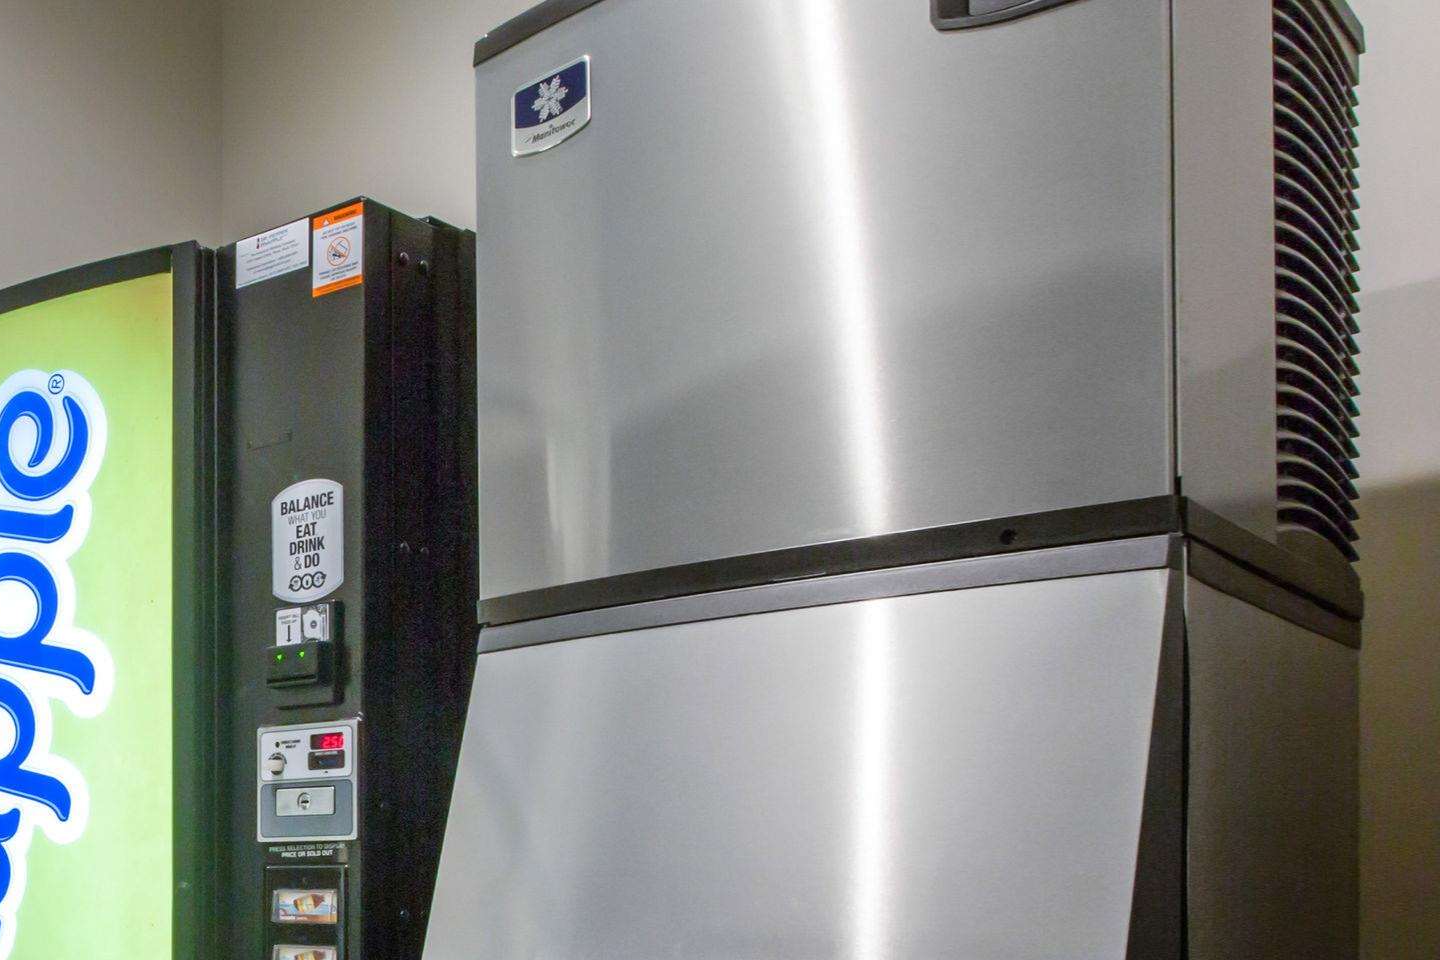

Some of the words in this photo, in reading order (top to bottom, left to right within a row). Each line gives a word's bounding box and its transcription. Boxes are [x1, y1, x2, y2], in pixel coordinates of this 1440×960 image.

[280, 491, 334, 516] BALANCE
[288, 512, 309, 525] WHAT
[311, 509, 326, 520] YOU
[296, 522, 317, 538] EAT
[289, 536, 325, 555] DRINK
[294, 556, 302, 570] &
[304, 553, 320, 568] DO
